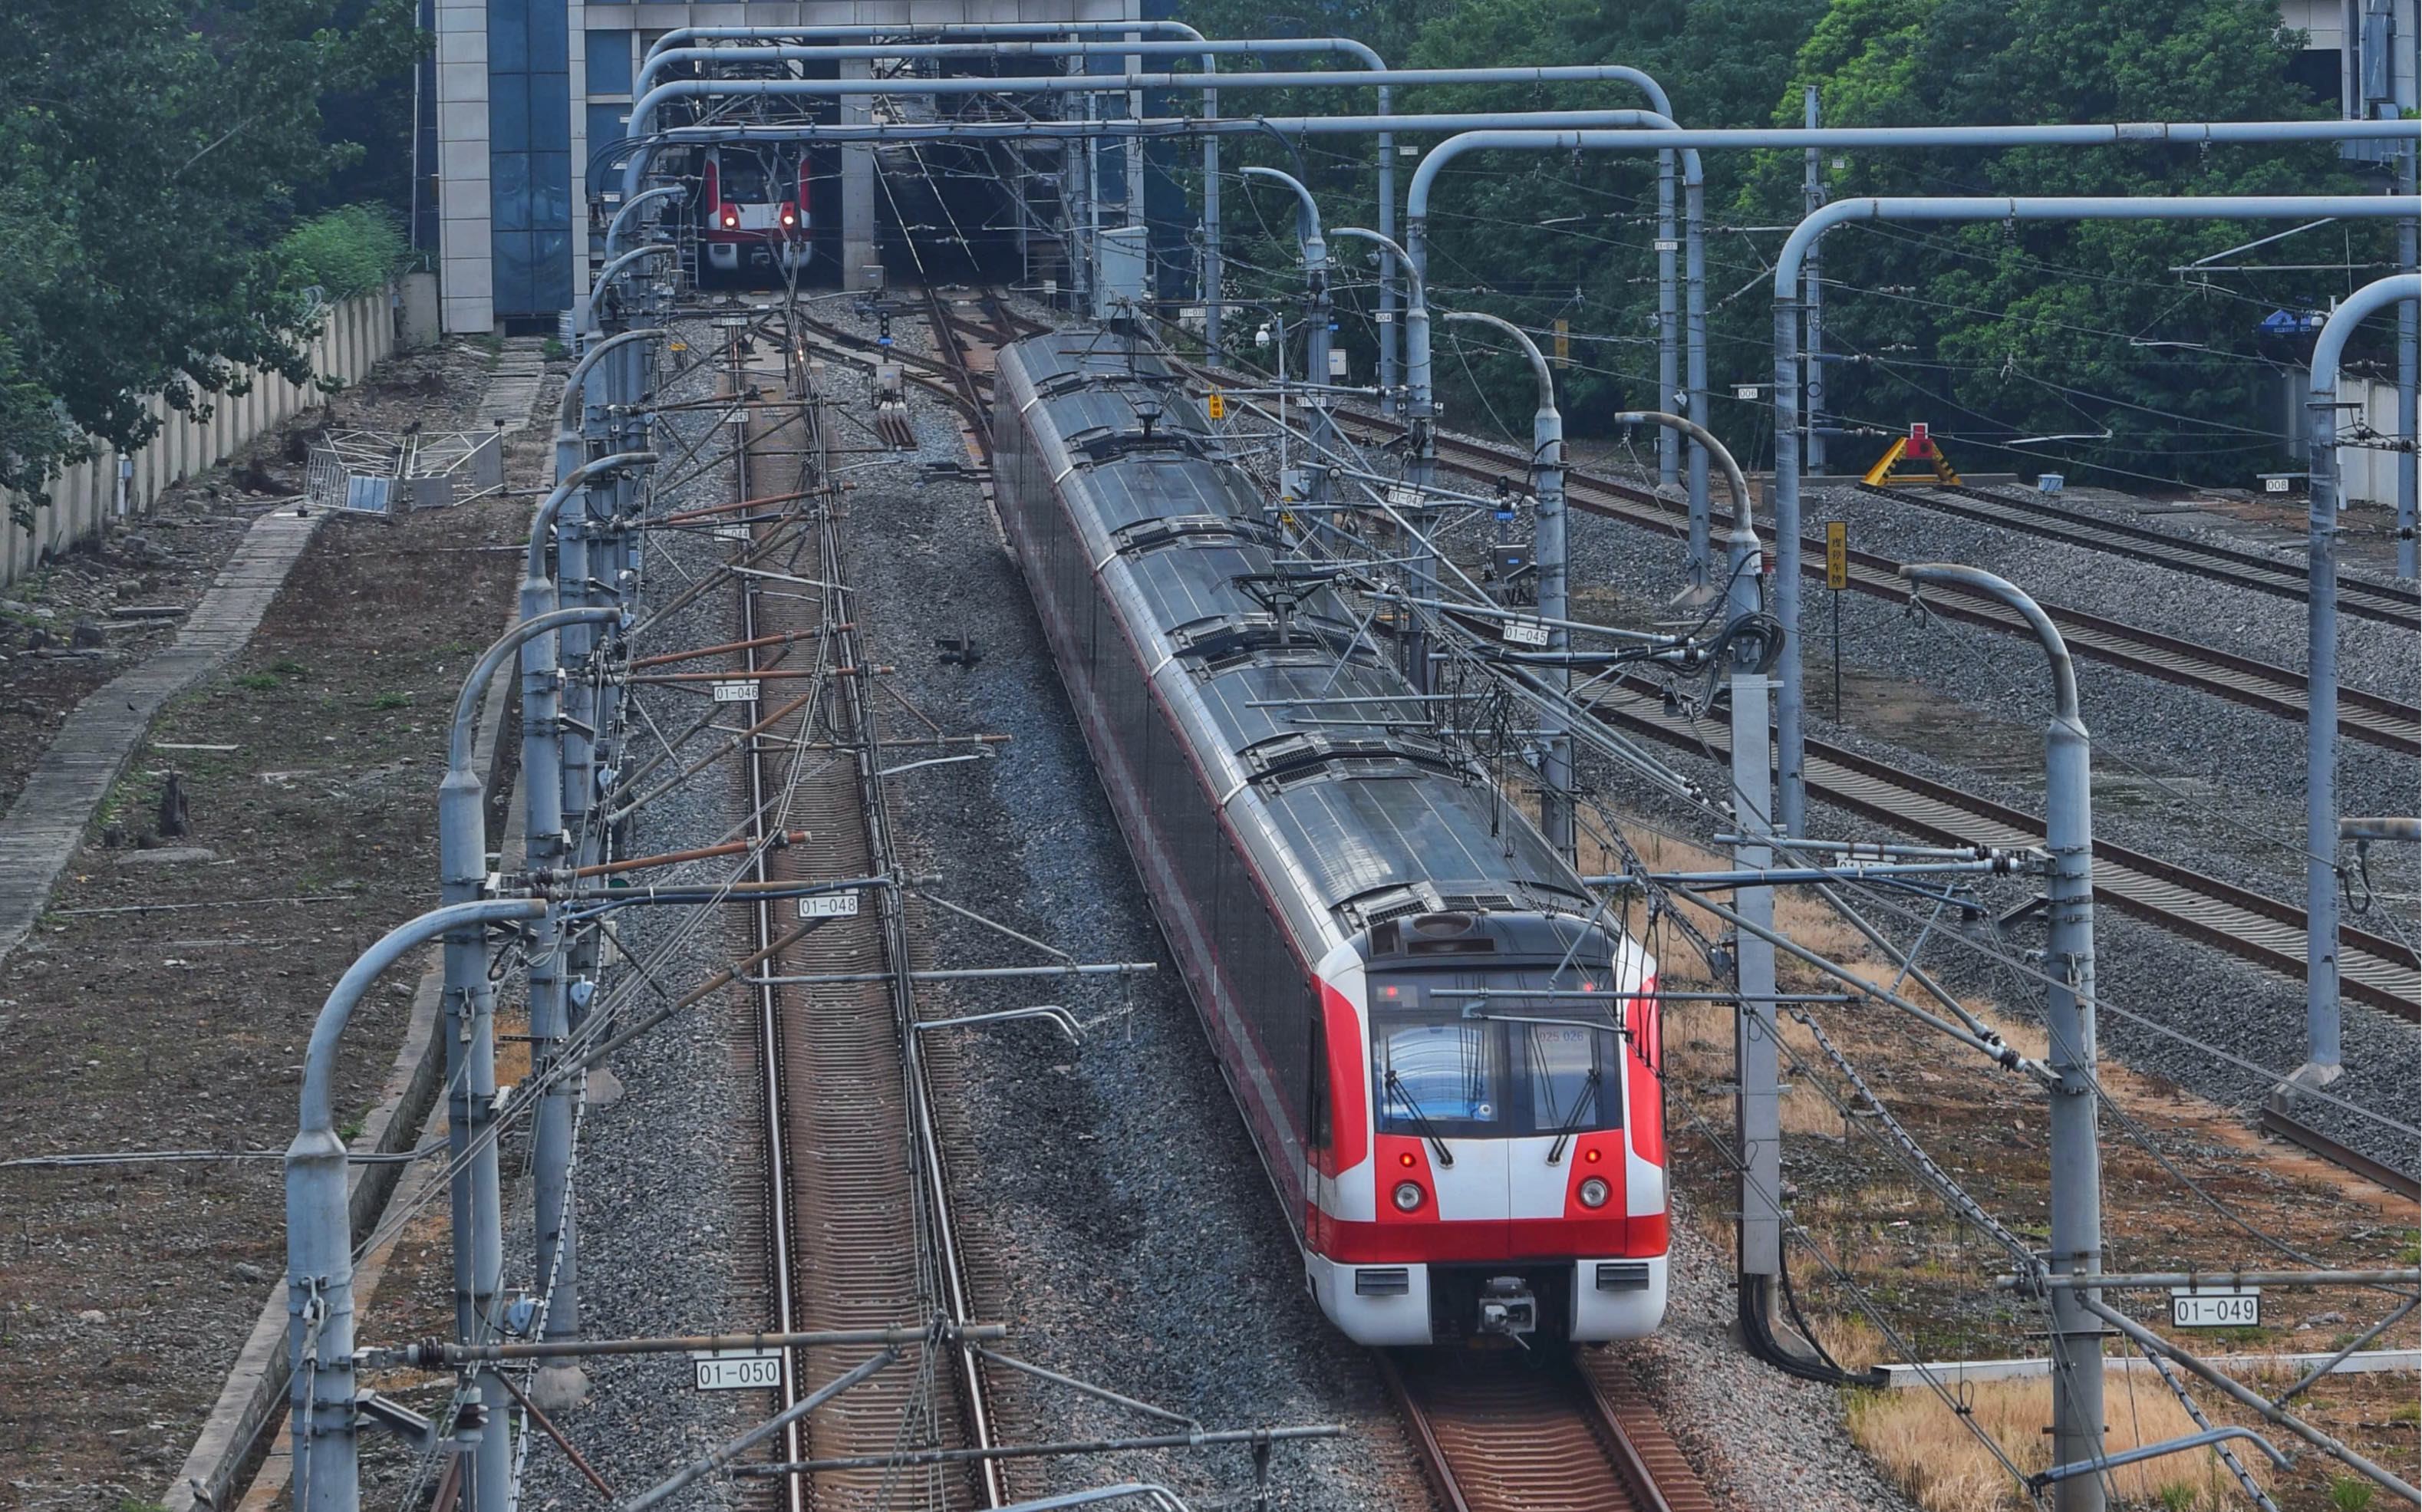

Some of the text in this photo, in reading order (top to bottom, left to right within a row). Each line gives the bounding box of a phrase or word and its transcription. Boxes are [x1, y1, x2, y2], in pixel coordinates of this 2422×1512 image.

[1739, 390, 1756, 398] 006
[2267, 480, 2287, 490] 008
[1389, 490, 1423, 508] 01-043
[1504, 626, 1547, 643] 01-045
[716, 687, 758, 700] 01-046
[801, 897, 857, 914] 01-048
[1539, 1030, 1584, 1042] 025 026
[2177, 1300, 2254, 1321] 01-049
[699, 1361, 777, 1385] 01-050
